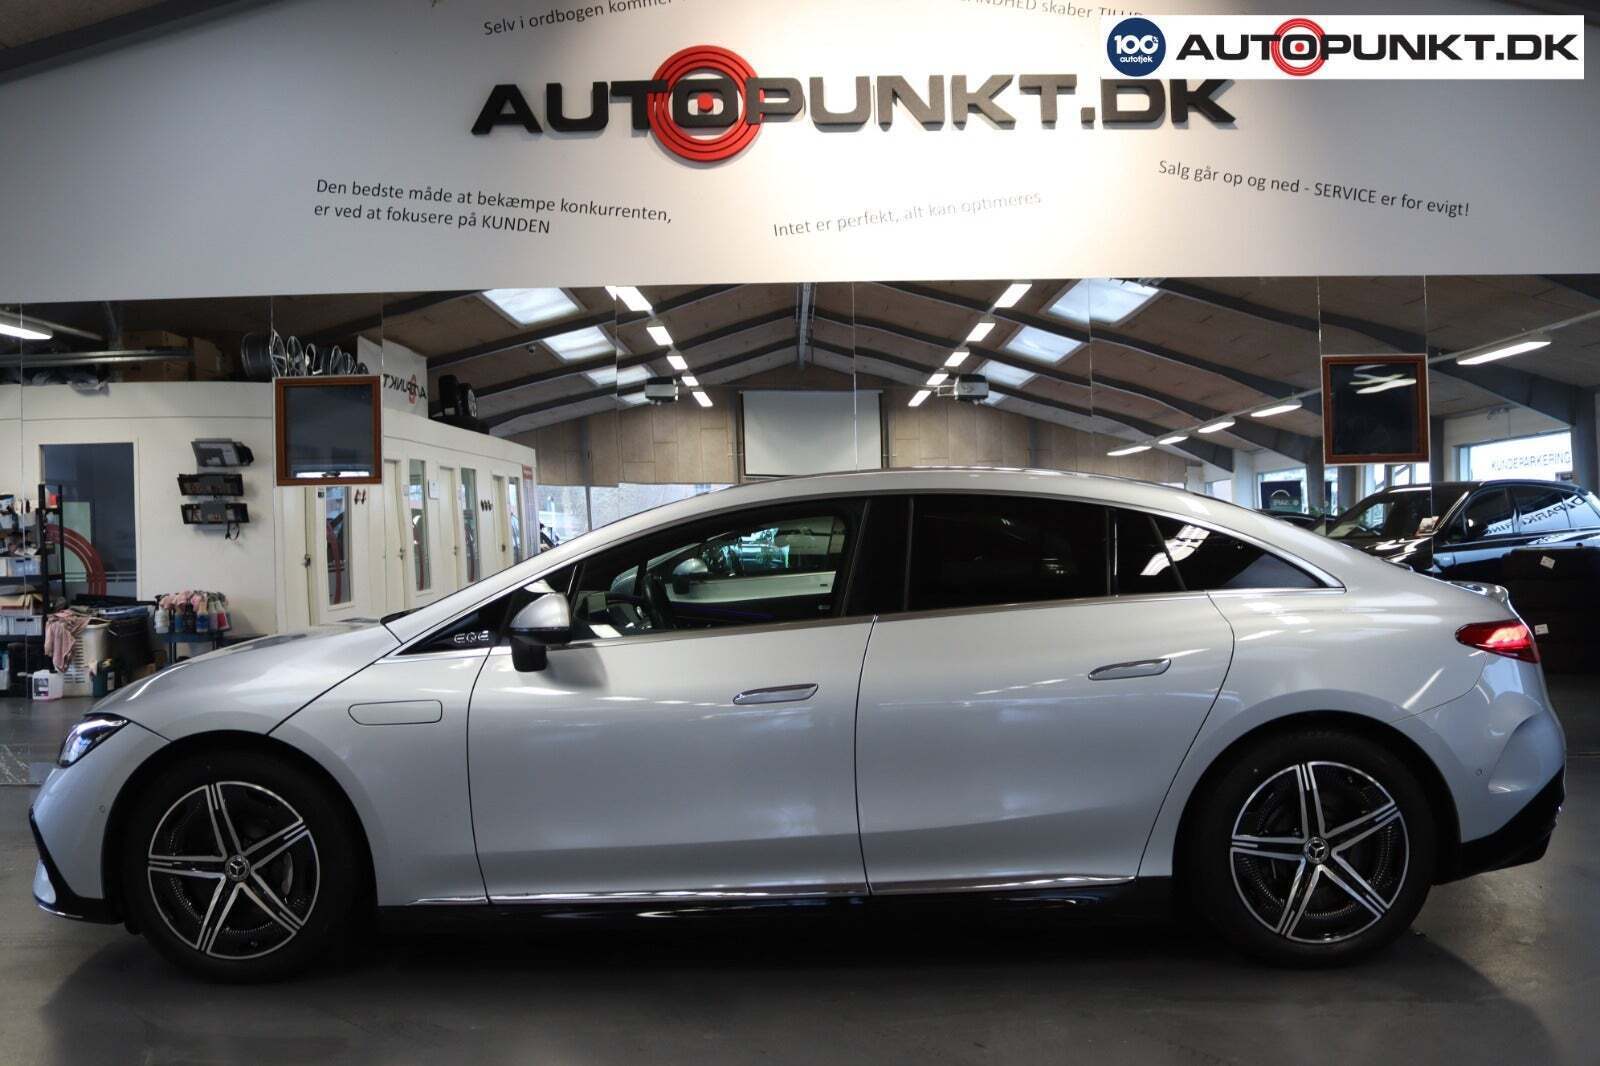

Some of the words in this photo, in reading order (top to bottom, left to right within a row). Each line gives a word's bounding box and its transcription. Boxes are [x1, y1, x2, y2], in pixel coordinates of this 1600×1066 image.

[484, 18, 515, 35] Selv
[520, 16, 524, 29] i
[529, 5, 604, 28] ordbogen
[1042, 0, 1093, 18] skaber
[472, 75, 1236, 133] AUTOPUNKT.DK
[316, 179, 347, 195] Den
[352, 181, 404, 199] bedste
[409, 186, 452, 202] måde
[457, 191, 473, 204] at
[478, 191, 555, 213] bekæmpe
[560, 198, 672, 224] konkurrenten,
[1159, 160, 1190, 181] Salg
[1194, 165, 1219, 184] går
[1223, 171, 1243, 188] op
[1247, 175, 1265, 192] og
[1270, 177, 1300, 194] ned
[1314, 182, 1377, 205] SERVICE
[1381, 194, 1397, 207] er
[1401, 193, 1423, 210] for
[1427, 201, 1470, 219] evigt!
[314, 204, 330, 216] er
[335, 205, 362, 218] ved
[366, 208, 382, 220] at
[387, 206, 453, 225] fokusere
[458, 212, 477, 229] på
[482, 215, 550, 234] KUNDEN
[773, 219, 811, 238] Intet
[816, 218, 831, 232] er
[837, 210, 900, 232] perfekt,
[904, 204, 924, 220] alt
[928, 201, 957, 217] kan
[961, 191, 1042, 214] optimeres
[454, 630, 489, 644] EQE
